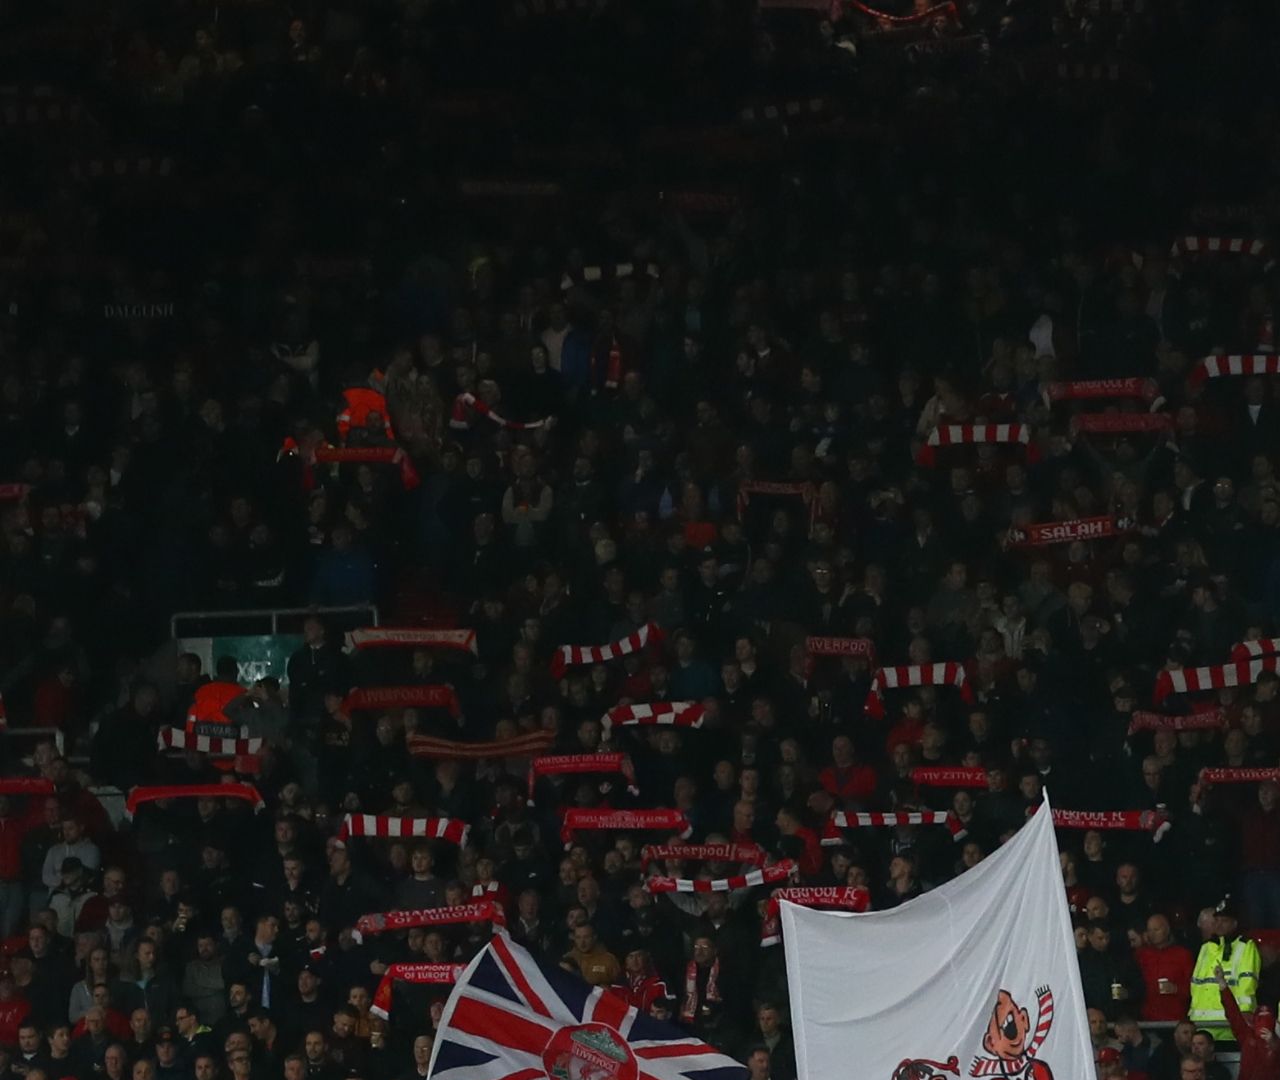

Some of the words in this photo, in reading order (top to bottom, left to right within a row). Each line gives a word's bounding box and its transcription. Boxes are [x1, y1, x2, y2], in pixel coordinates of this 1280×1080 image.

[1041, 521, 1103, 540] SALAH
[657, 844, 731, 859] Liverpool
[388, 903, 488, 919] CHAMPIONS
[396, 965, 452, 973] CHAMPIONS
[404, 972, 415, 980] OF
[417, 972, 450, 980] EUROPE
[575, 1049, 616, 1073] LIVERPOOL
